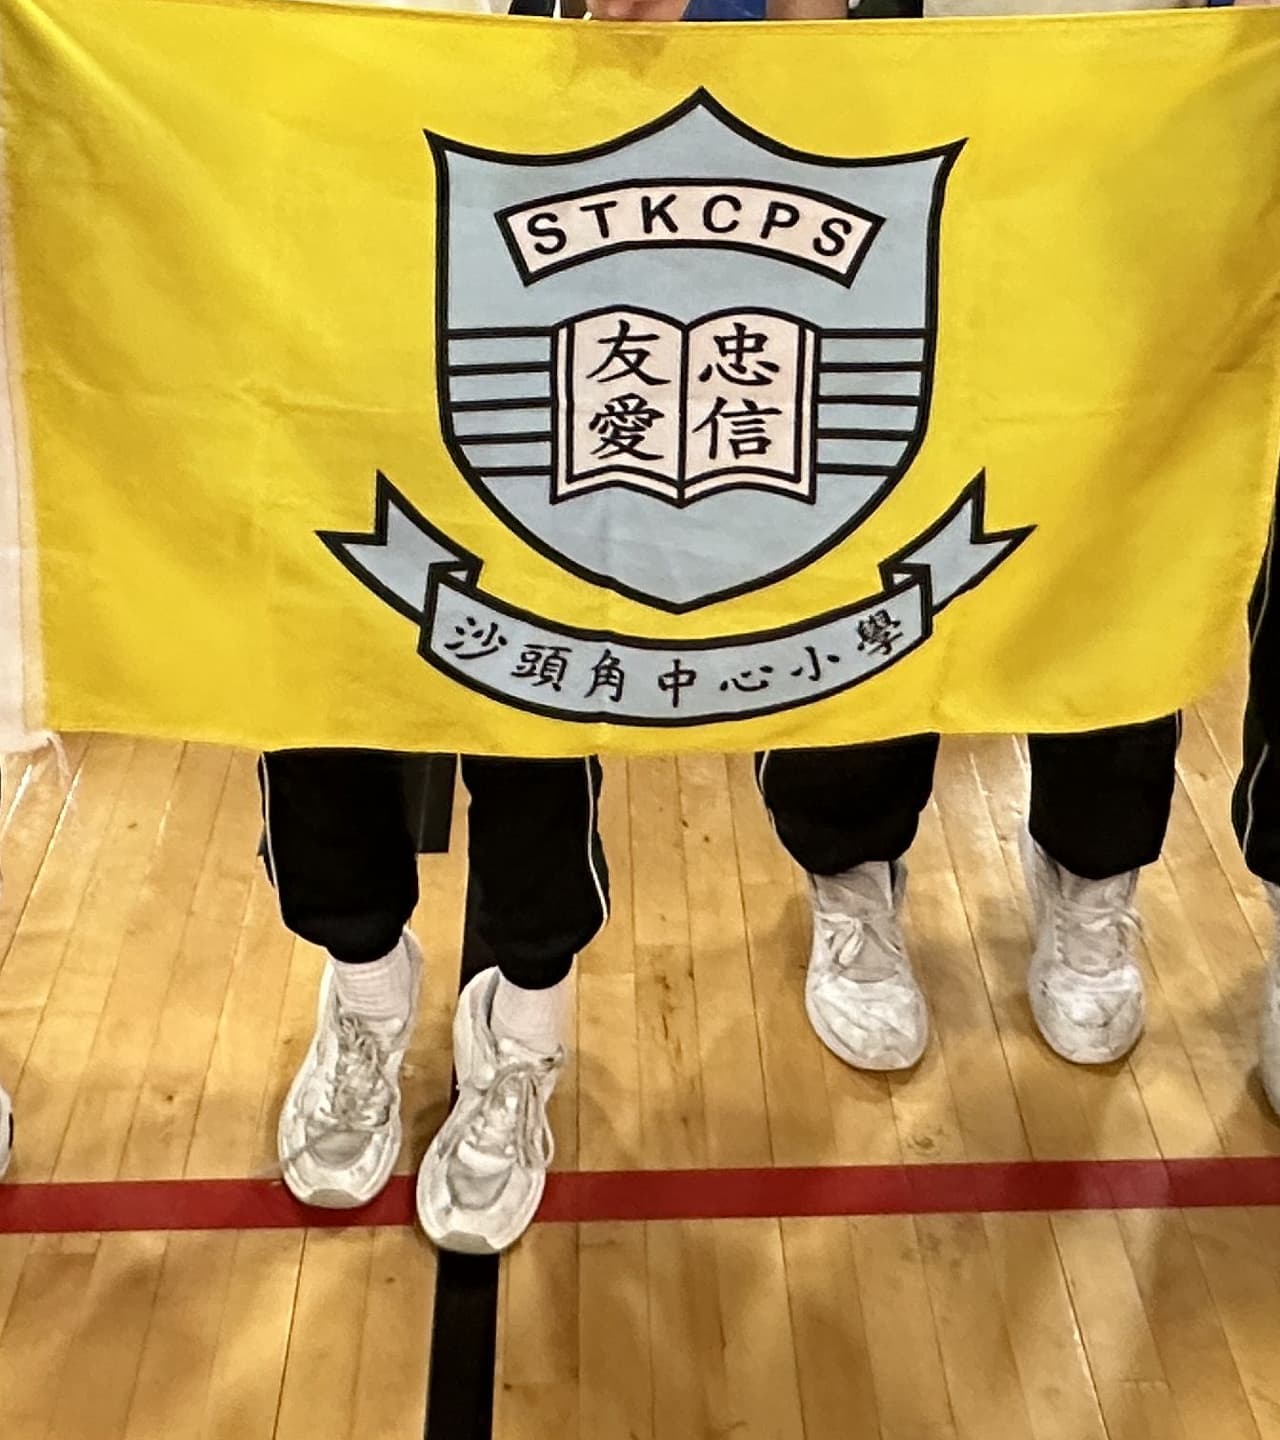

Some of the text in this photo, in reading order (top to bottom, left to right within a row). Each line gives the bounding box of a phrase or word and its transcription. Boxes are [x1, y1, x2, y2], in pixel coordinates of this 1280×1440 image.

[526, 193, 853, 258] STKCPS
[443, 611, 906, 709] 沙頭角中心小學
